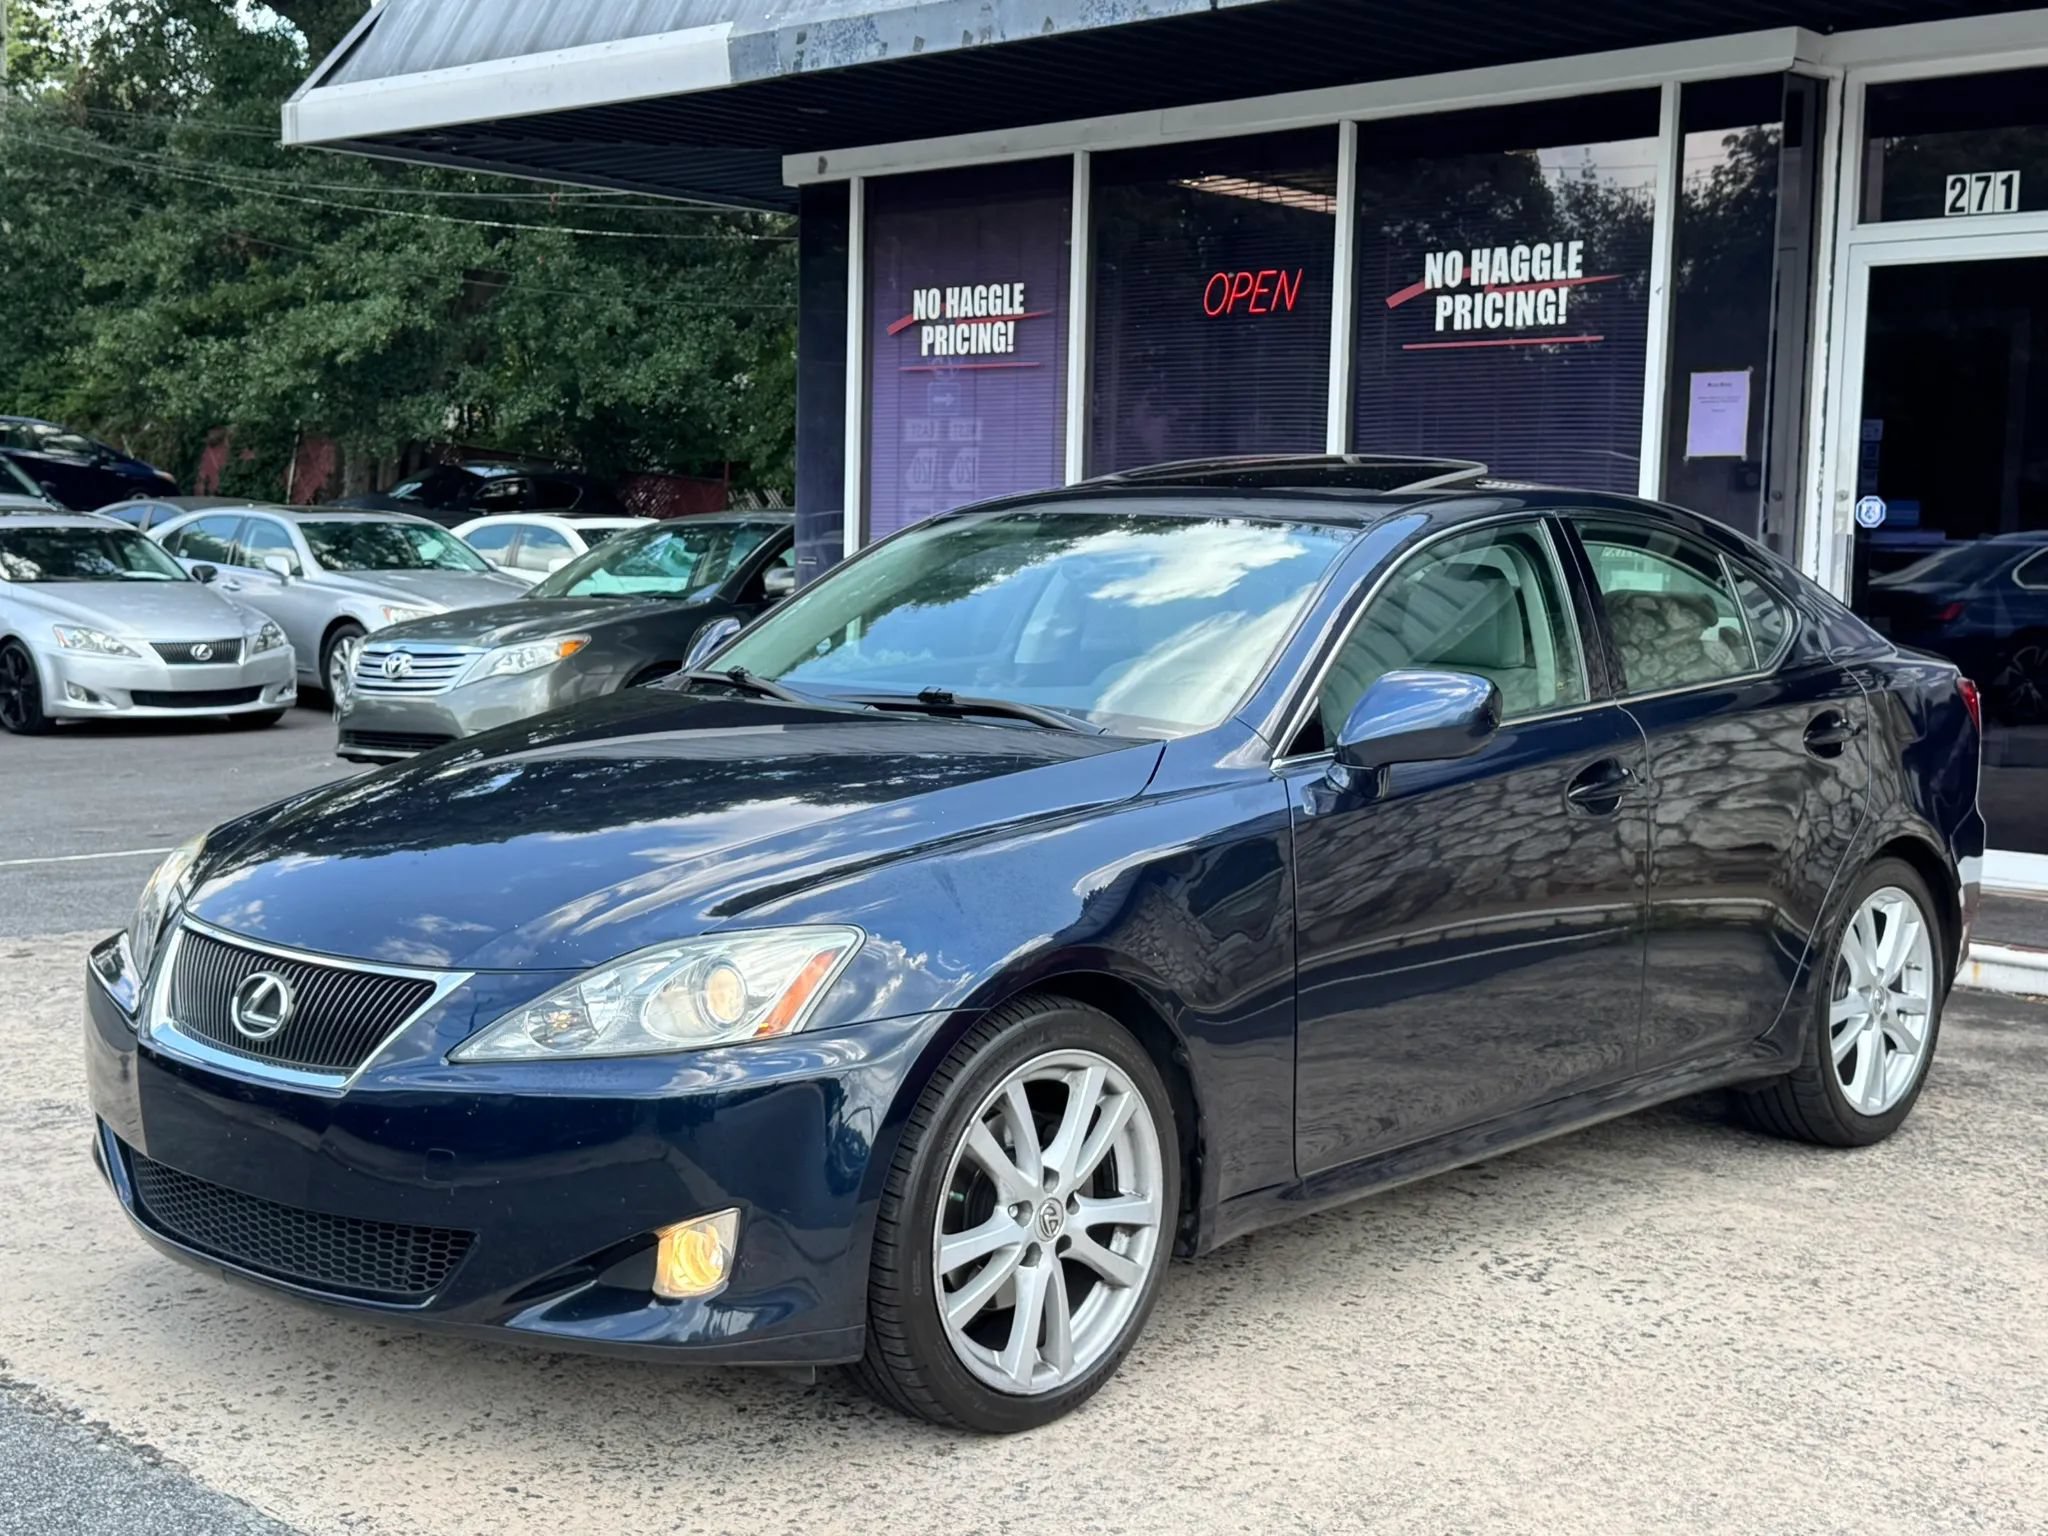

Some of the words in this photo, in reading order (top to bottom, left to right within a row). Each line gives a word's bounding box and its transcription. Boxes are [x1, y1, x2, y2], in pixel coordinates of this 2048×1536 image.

[1948, 173, 2014, 213] 271
[1424, 250, 1464, 290] NO
[1470, 240, 1584, 286] HAGGLE
[912, 287, 942, 321] NO
[945, 282, 1025, 318] HAGGLE
[1203, 267, 1303, 316] OPEN
[1434, 286, 1569, 332] PRICING!
[920, 321, 1015, 356] PRICING!
